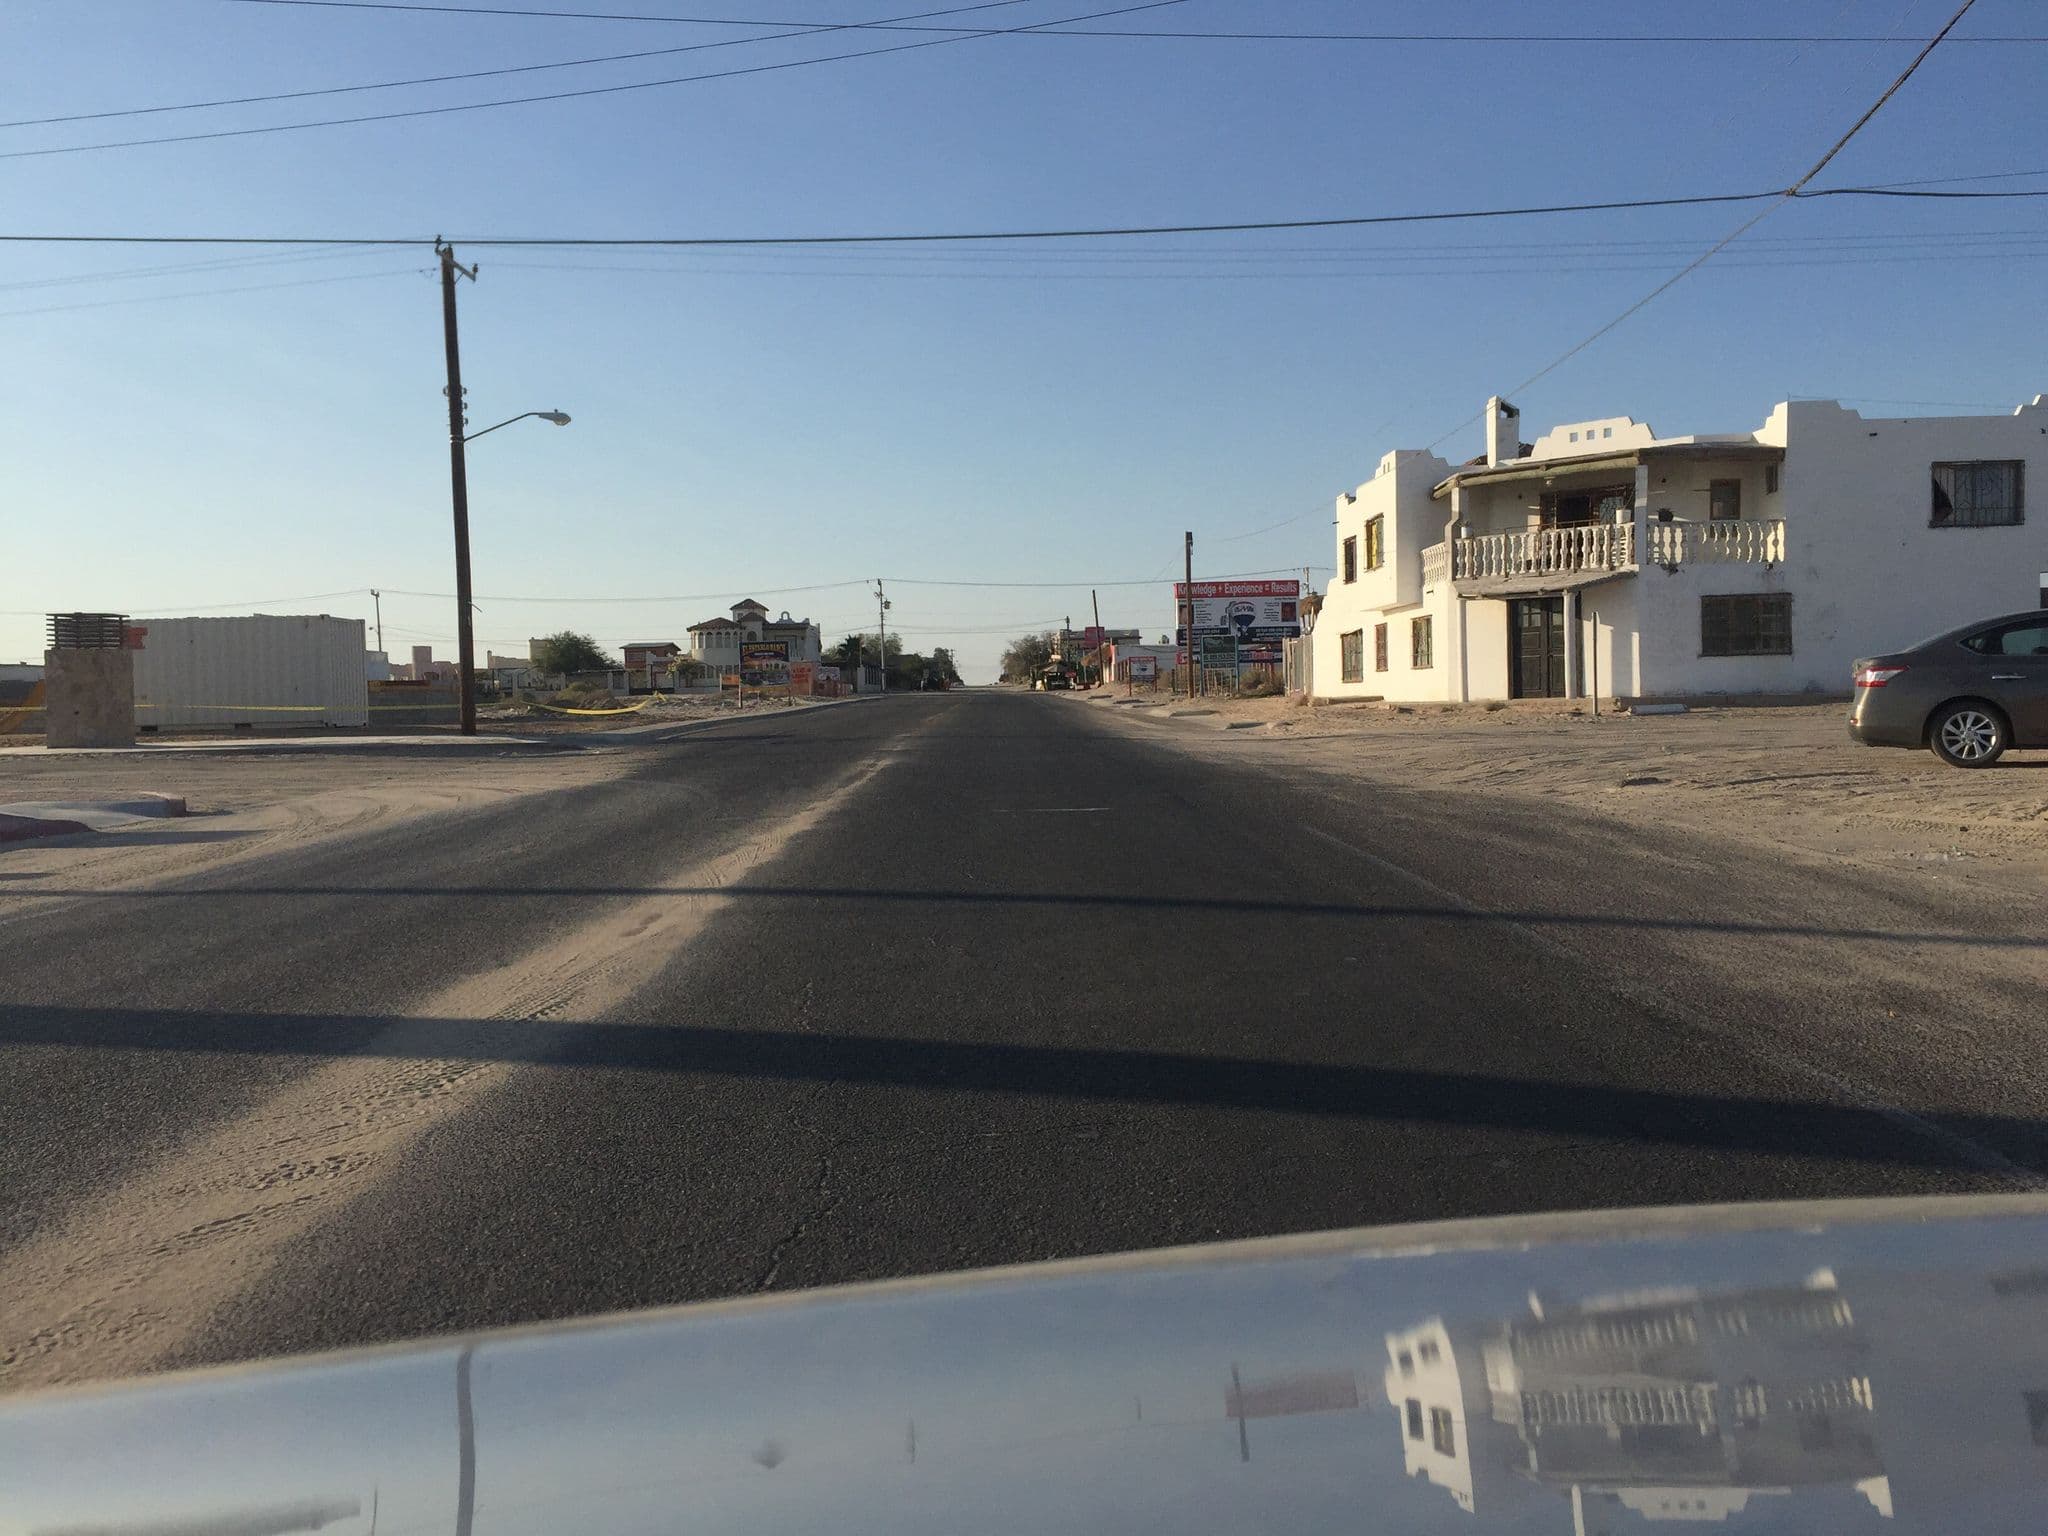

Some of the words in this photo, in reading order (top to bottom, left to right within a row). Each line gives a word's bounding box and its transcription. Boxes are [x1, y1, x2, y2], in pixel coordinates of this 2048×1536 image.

[1178, 583, 1217, 597] Knwledge
[1224, 583, 1263, 596] Experience
[1271, 581, 1298, 593] Results
